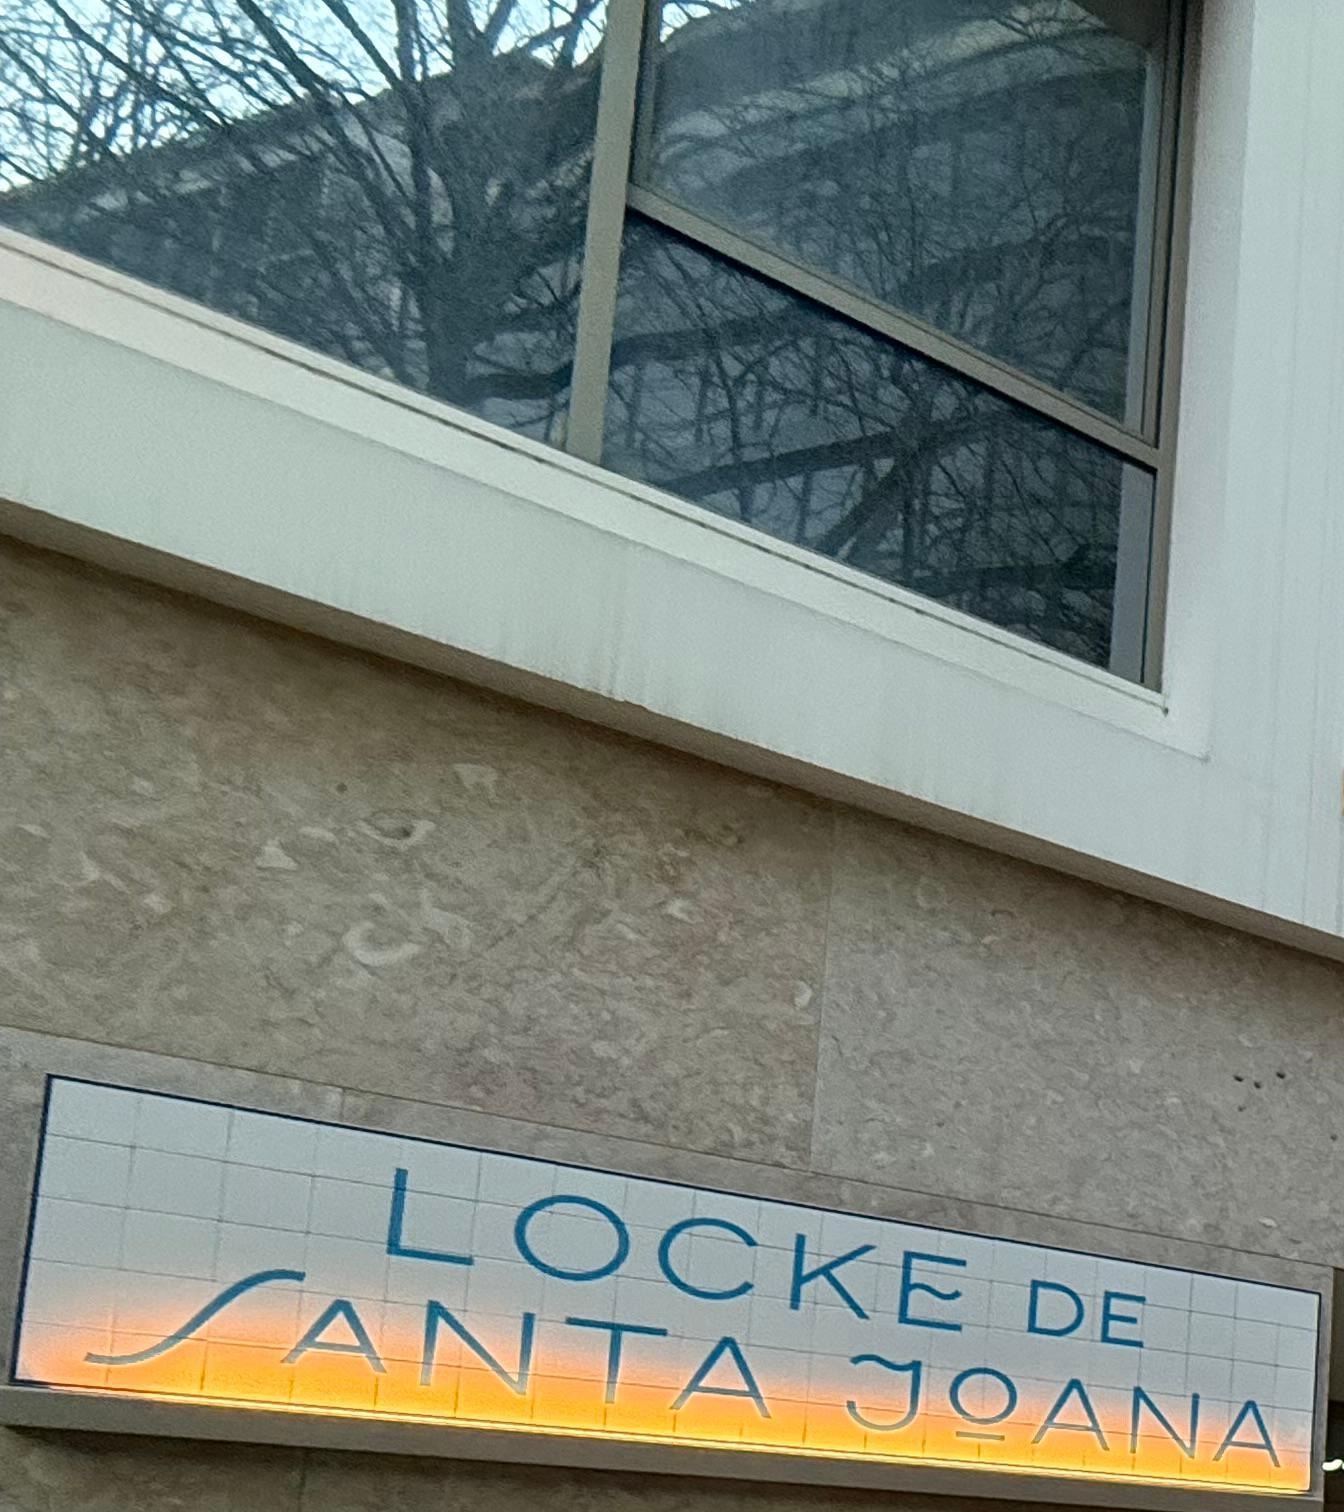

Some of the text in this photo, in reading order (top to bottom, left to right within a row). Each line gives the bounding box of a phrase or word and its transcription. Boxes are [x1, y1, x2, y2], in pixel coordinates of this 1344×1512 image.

[386, 1167, 1146, 1348] LOCKE DE
[84, 1269, 1281, 1468] SANTA JOANA
